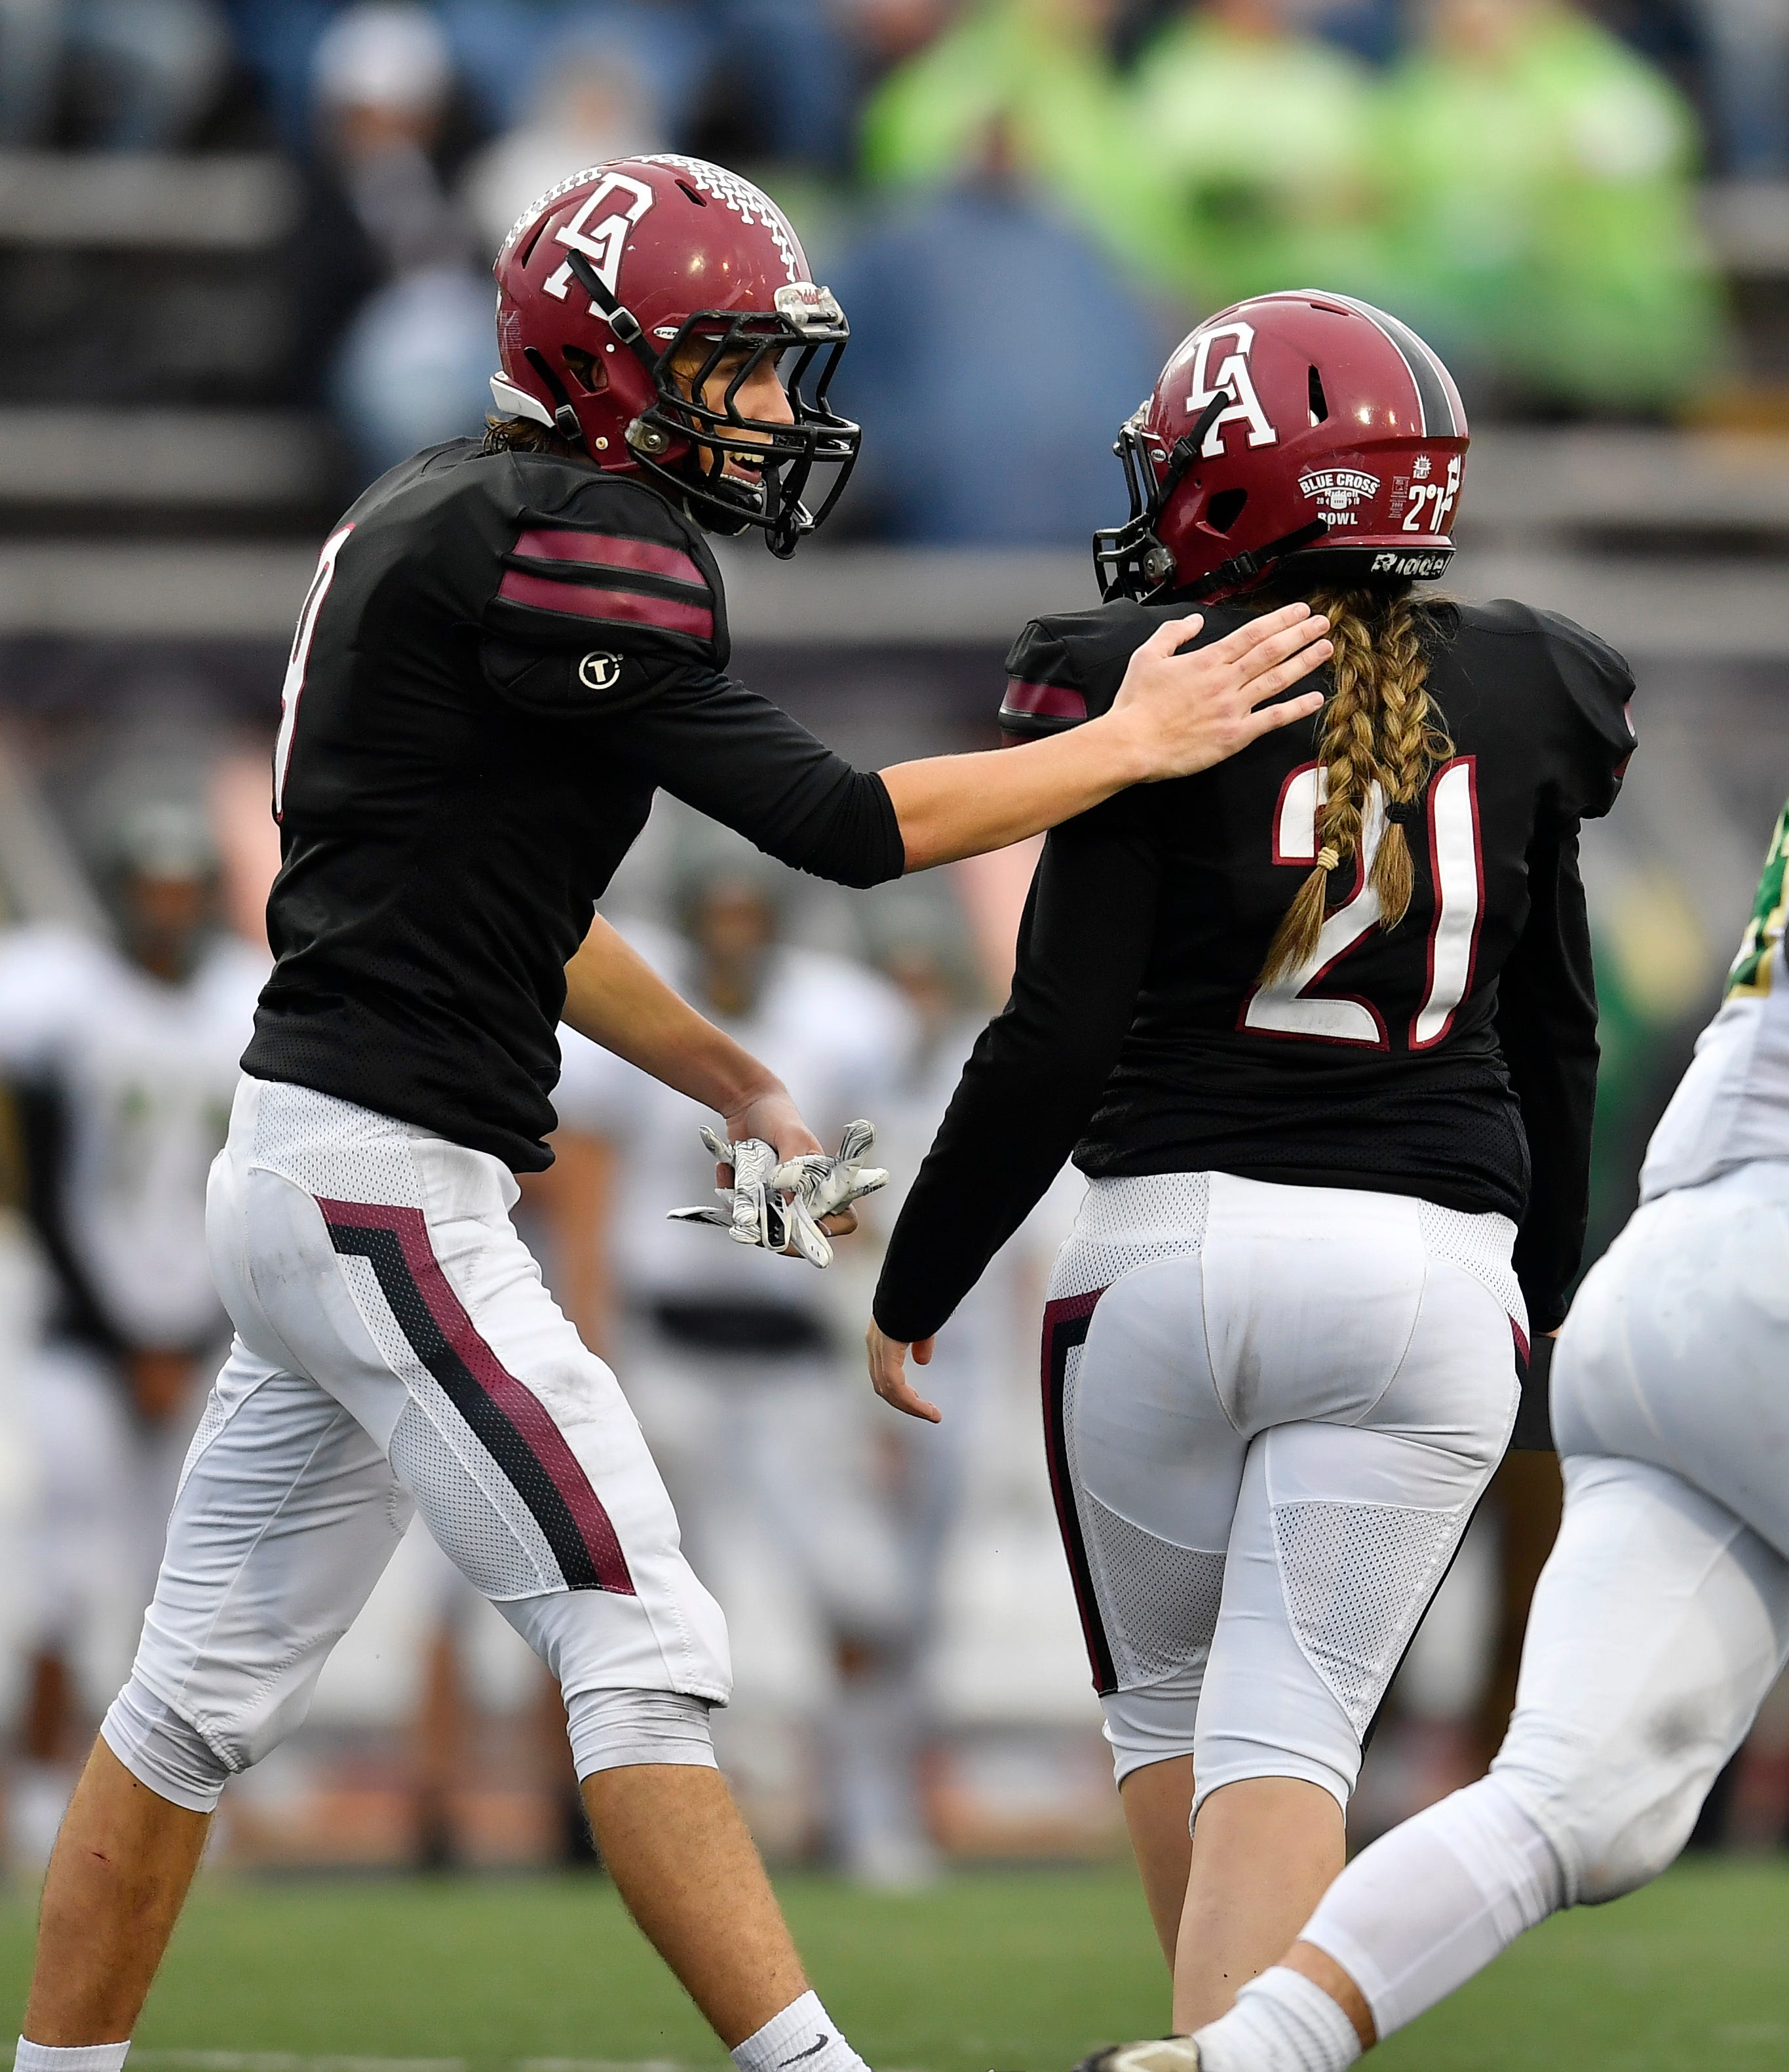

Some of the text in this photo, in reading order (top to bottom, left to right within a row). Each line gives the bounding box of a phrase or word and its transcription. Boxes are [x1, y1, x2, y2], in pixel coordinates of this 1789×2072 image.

[1299, 474, 1334, 494] BLUE
[1336, 473, 1379, 494] CROSS
[1402, 484, 1445, 531] 21
[1235, 754, 1486, 1052] 21
